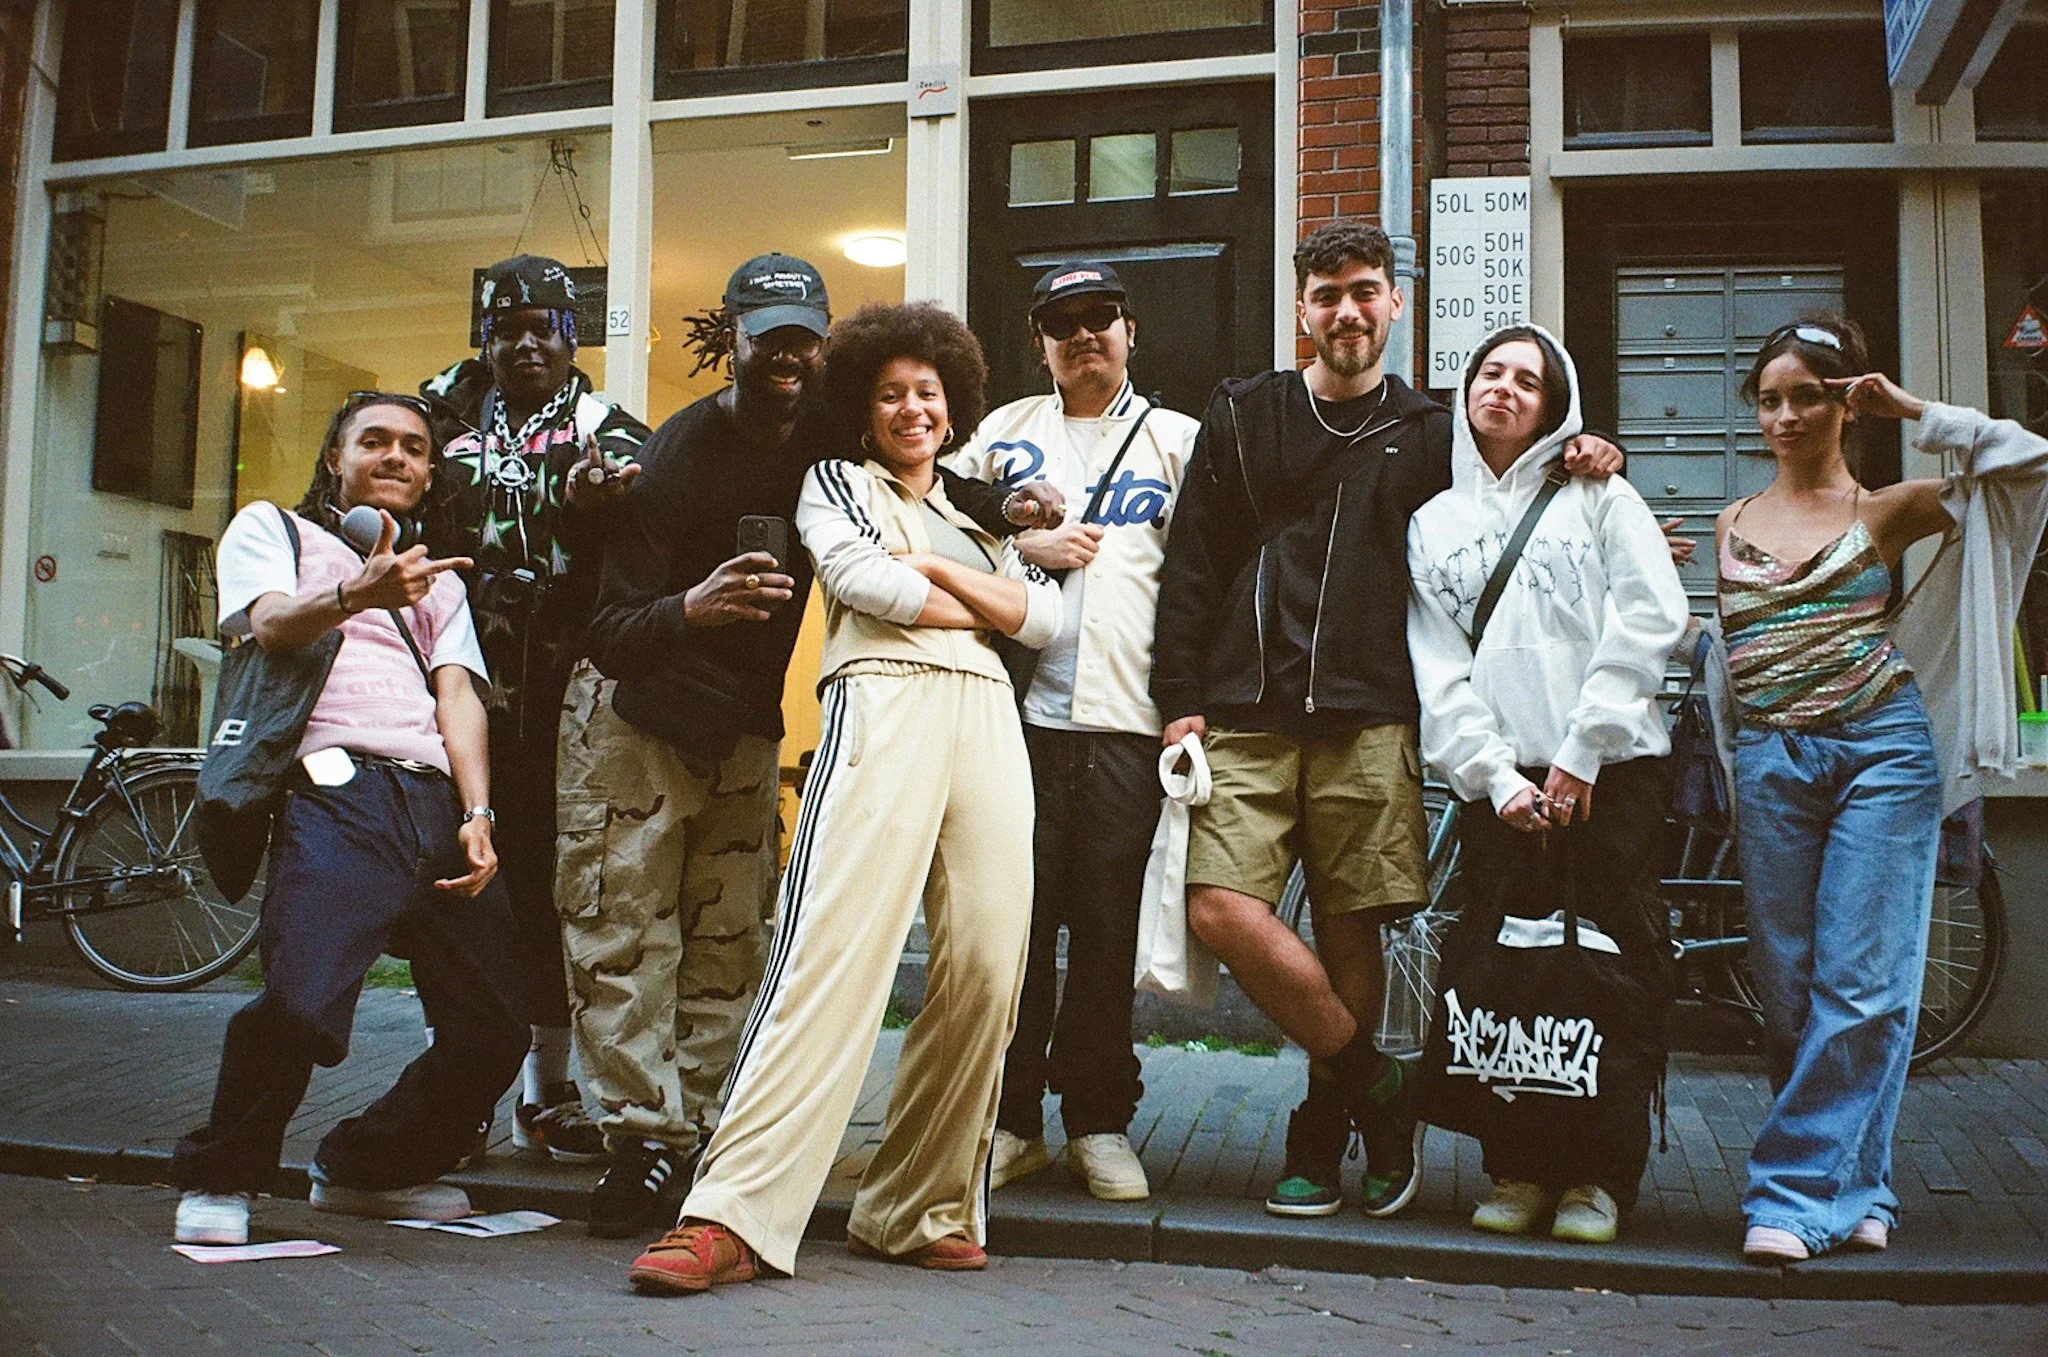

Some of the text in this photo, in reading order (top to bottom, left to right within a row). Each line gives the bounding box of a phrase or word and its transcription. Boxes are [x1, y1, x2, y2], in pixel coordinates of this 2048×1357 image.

[1436, 191, 1527, 214] 50L 50M
[1484, 232, 1524, 252] 50H
[1436, 245, 1476, 266] 50G
[1484, 258, 1524, 279] 50K
[1483, 284, 1523, 305] 50E
[1435, 297, 1475, 319] 50D
[609, 310, 629, 330] 52
[985, 438, 1170, 531] Ptta
